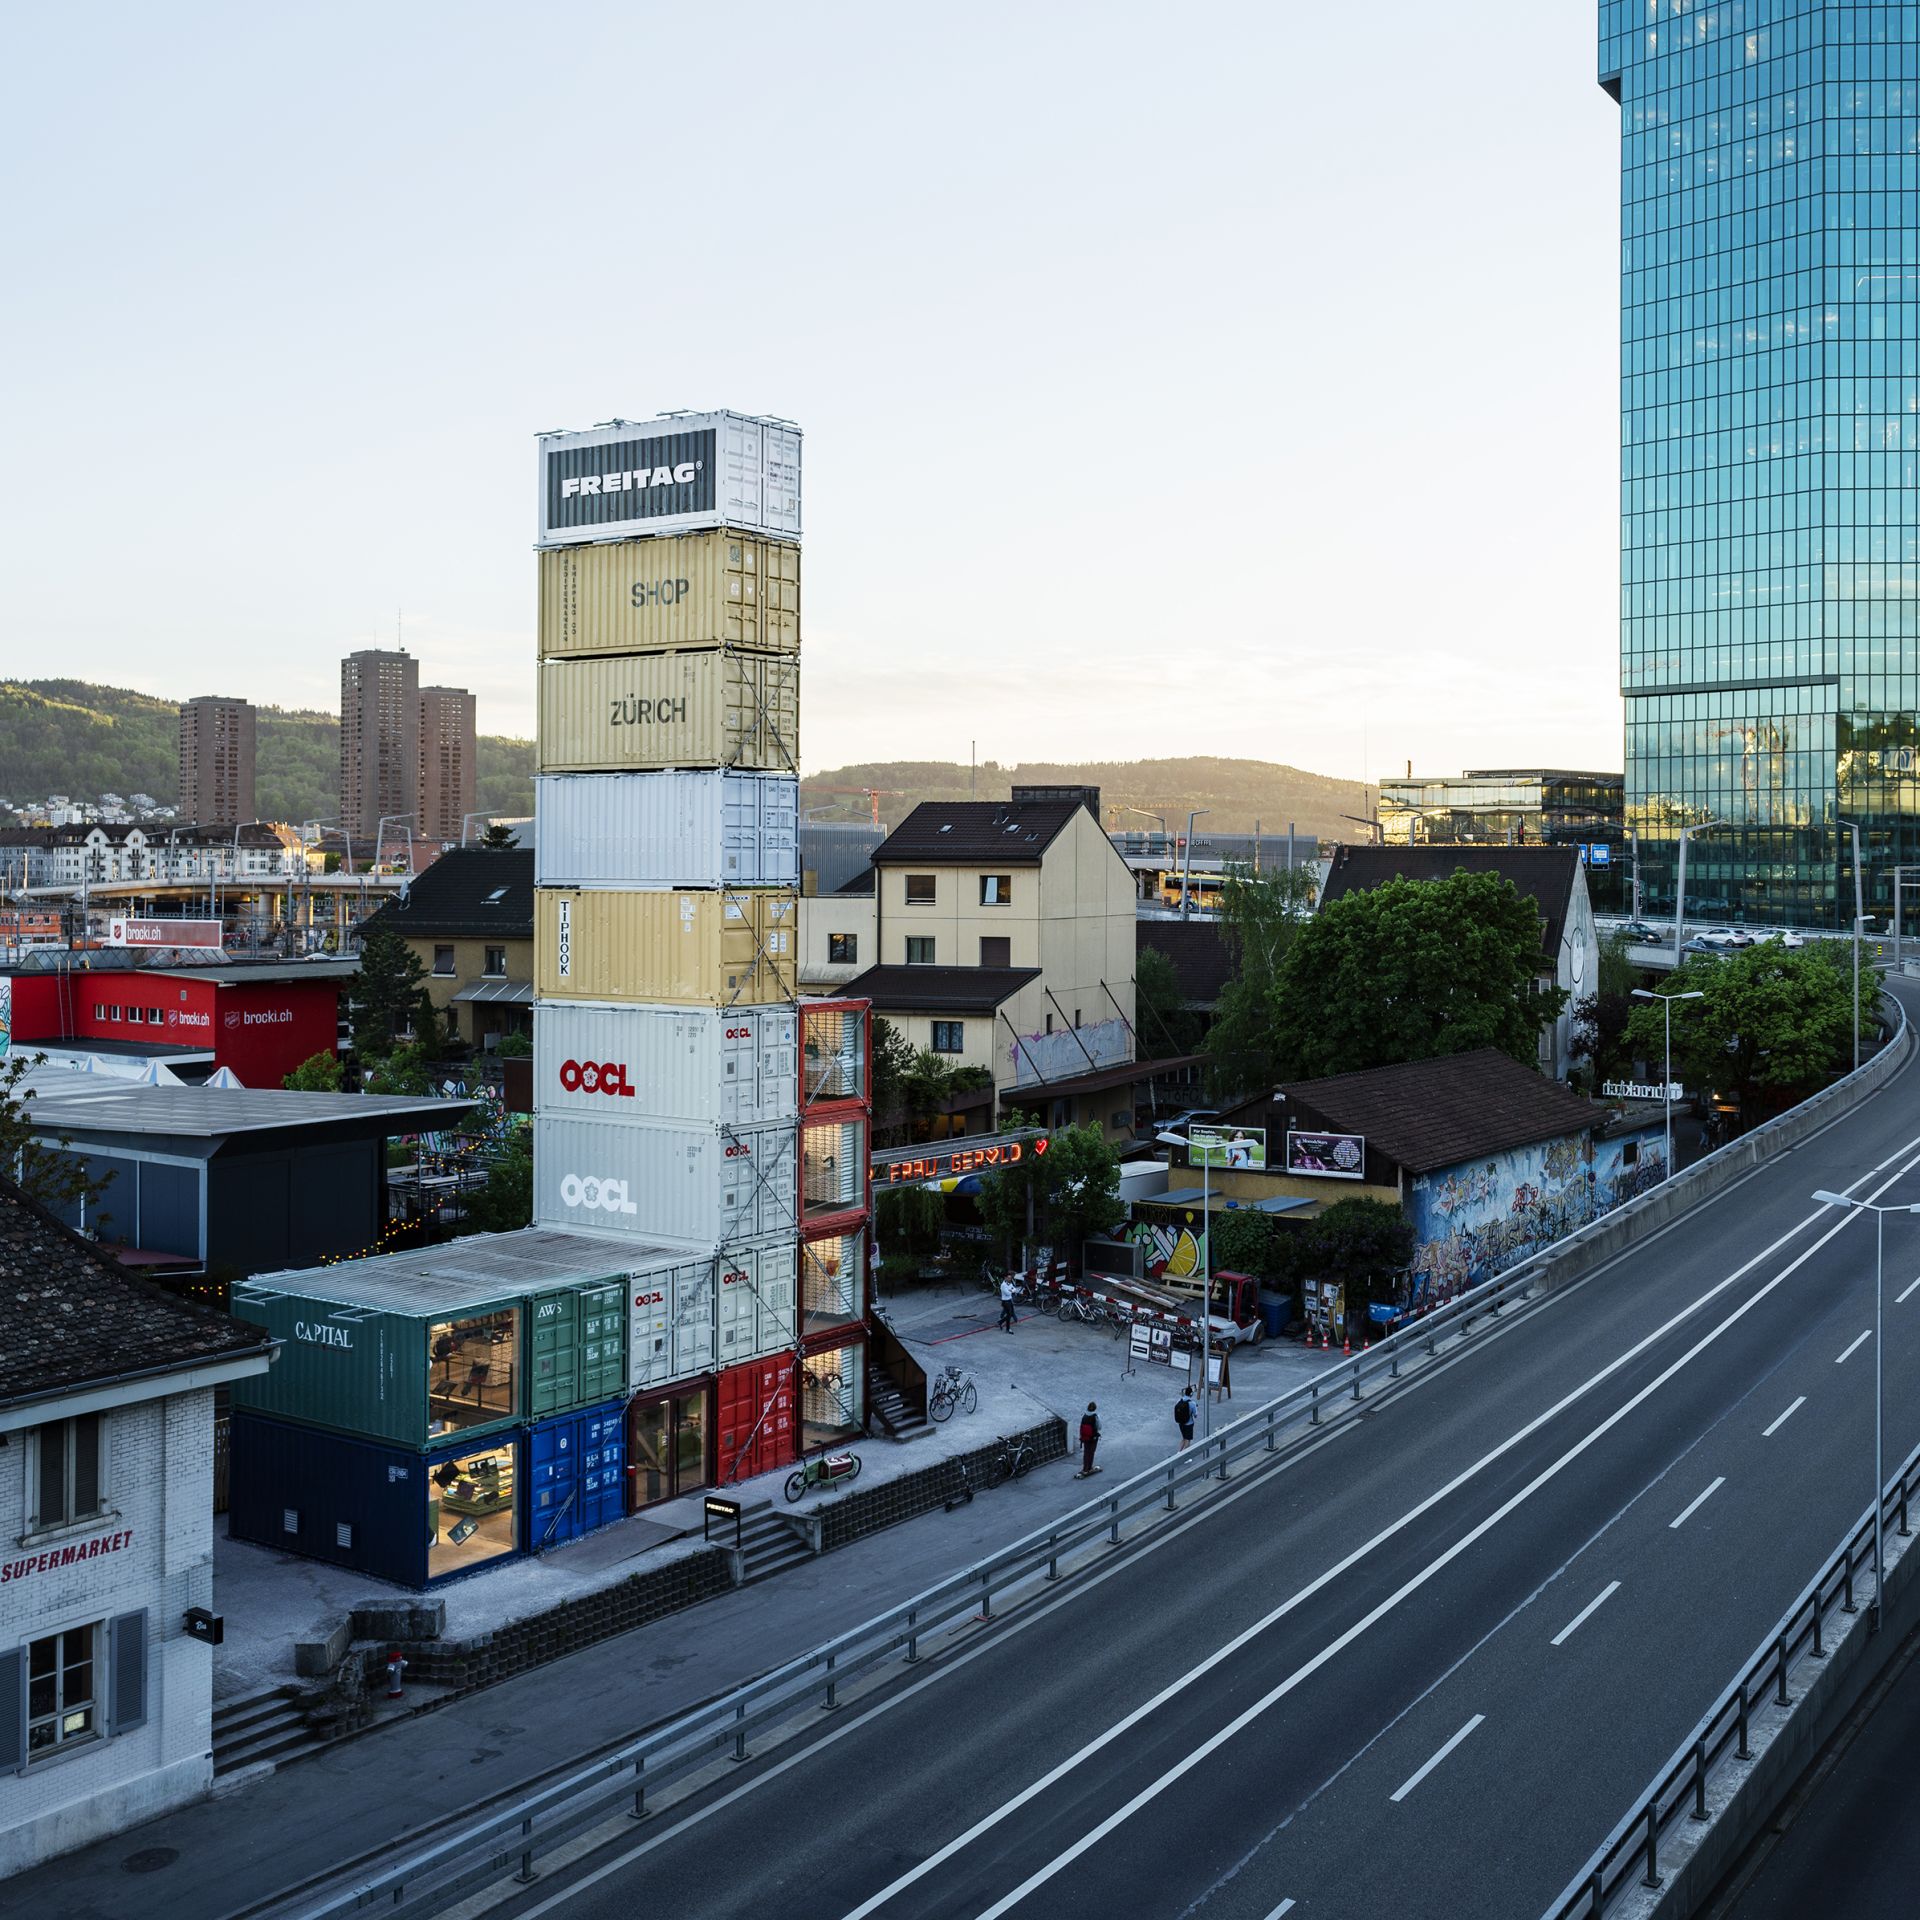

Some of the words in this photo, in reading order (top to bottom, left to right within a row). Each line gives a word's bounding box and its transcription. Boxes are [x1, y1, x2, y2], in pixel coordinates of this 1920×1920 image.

[631, 578, 690, 608] SHOP
[610, 693, 686, 726] ZÜRICH
[127, 925, 161, 941] brocki.ch
[560, 901, 570, 975] TIPHOOK
[179, 1010, 210, 1027] brocki.ch
[243, 1009, 293, 1025] brocki.ch
[726, 1027, 751, 1039] OOCL
[559, 1059, 635, 1097] OOCL
[889, 1158, 938, 1184] FRAU
[560, 1174, 637, 1214] OOCL
[537, 1302, 562, 1318] AWS
[295, 1321, 353, 1348] CAPITAL
[0, 1530, 133, 1583] SUPERMARKET
